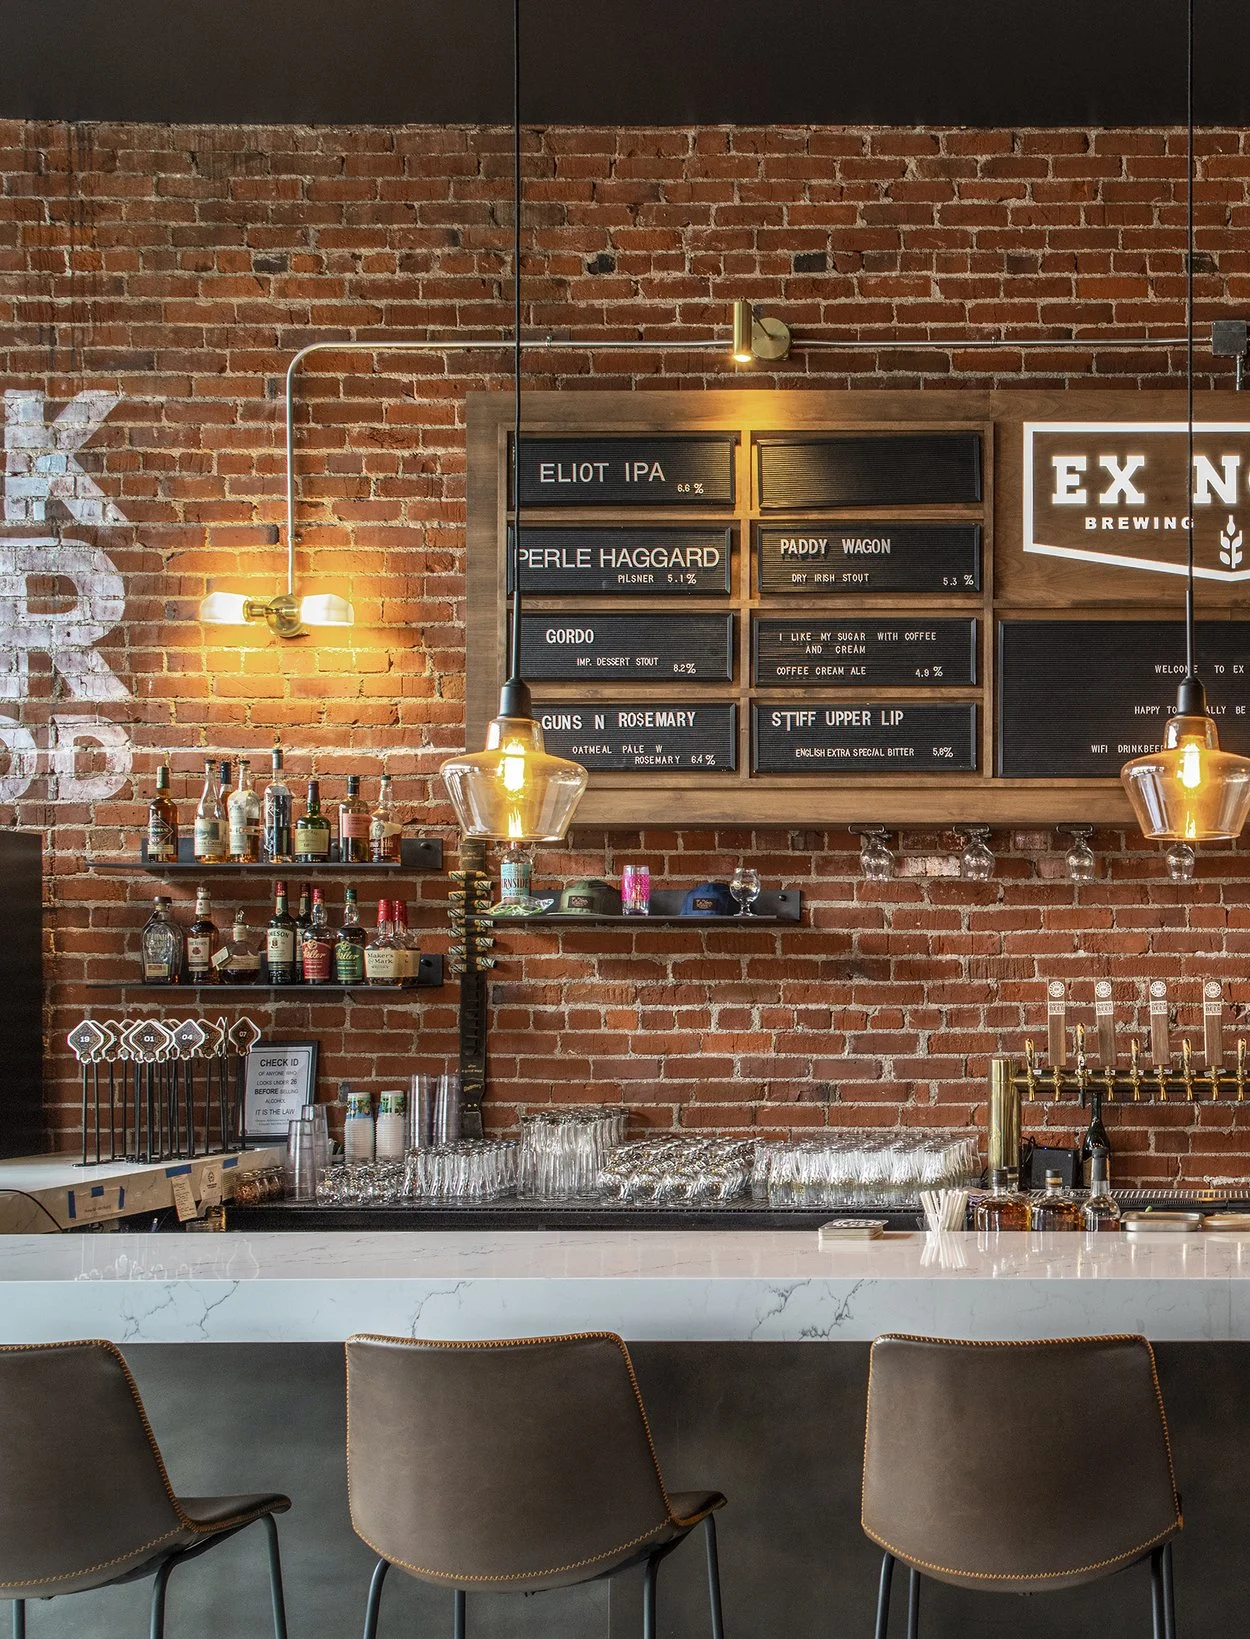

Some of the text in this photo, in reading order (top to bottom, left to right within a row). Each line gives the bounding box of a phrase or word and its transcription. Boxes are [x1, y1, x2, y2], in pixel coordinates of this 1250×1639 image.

[540, 462, 666, 483] ELIOT IPA
[1052, 455, 1145, 504] EX
[1084, 516, 1194, 530] BREWING
[780, 538, 891, 554] PADDY WAGON
[514, 547, 720, 568] PERLE HAGGARD
[618, 574, 654, 584] PILSNER
[792, 572, 870, 583] DRY IRISH STOUT
[546, 628, 594, 644] GORDO
[790, 632, 812, 641] LIKE
[820, 632, 832, 641] MY
[837, 632, 866, 641] SUGAR
[877, 632, 898, 641] WITH
[904, 632, 937, 641] COFFEE
[805, 644, 866, 654] AND CREAM
[576, 657, 659, 666] IMP. DESSERT STOUT
[776, 666, 866, 675] COFFEE CREAM ALE
[1214, 664, 1225, 674] TO
[1232, 664, 1244, 674] EX
[1134, 706, 1160, 714] HAPPY
[1235, 706, 1246, 714] BE
[542, 715, 582, 730] GUNS
[594, 714, 605, 730] N
[771, 710, 904, 731] STIFF UPPER LIP
[572, 744, 663, 754] OATMEAL PALE W
[795, 748, 826, 758] ENGLISH
[827, 748, 851, 757] EXTRA
[852, 747, 885, 757] SPECIAL
[887, 748, 915, 757] BITTER
[1091, 744, 1108, 753] WIFI
[634, 756, 681, 764] ROSEMARY
[260, 1058, 299, 1067] CHECK ID
